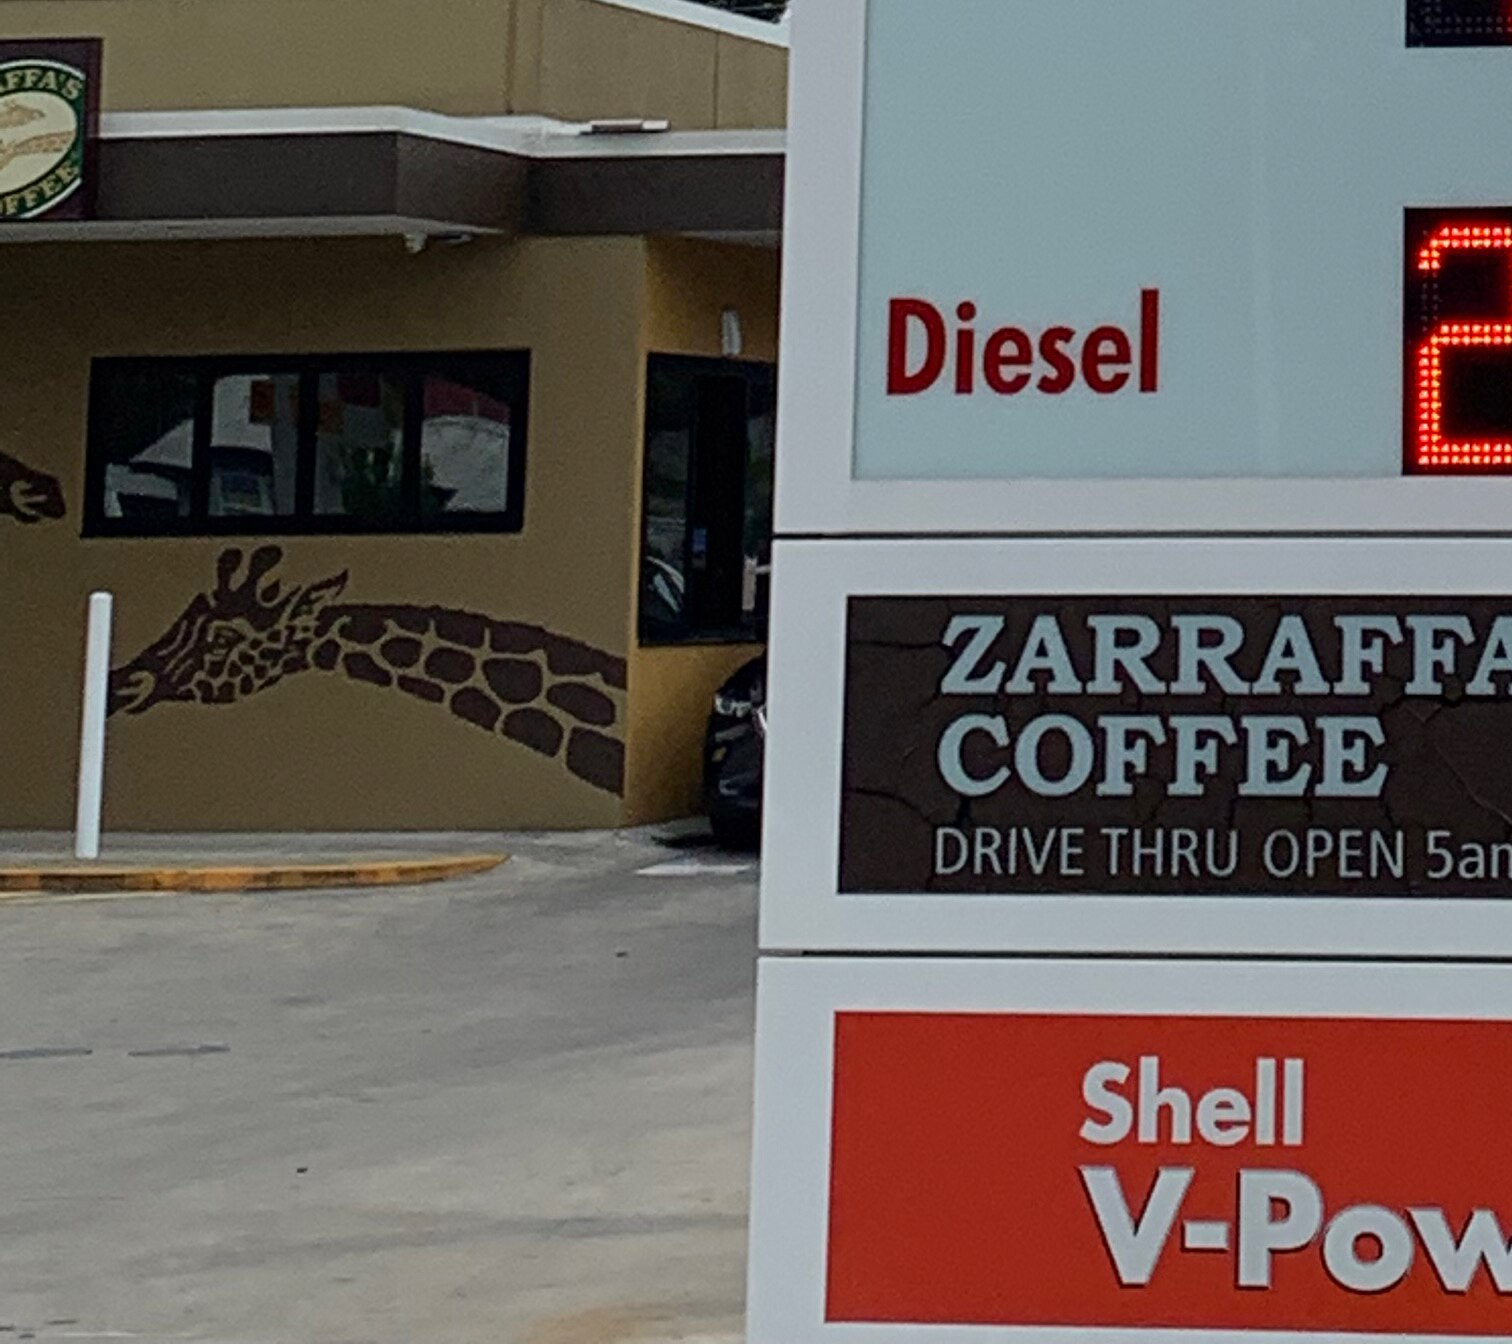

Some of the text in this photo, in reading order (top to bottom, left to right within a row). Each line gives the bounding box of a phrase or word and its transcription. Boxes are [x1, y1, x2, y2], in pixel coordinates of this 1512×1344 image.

[886, 289, 1159, 395] Diesel
[937, 713, 1389, 798] COFFEE
[934, 827, 1091, 877] DRIVE
[1100, 827, 1239, 878] THRU
[1264, 829, 1405, 880] OPEN
[1079, 1055, 1305, 1147] Shell
